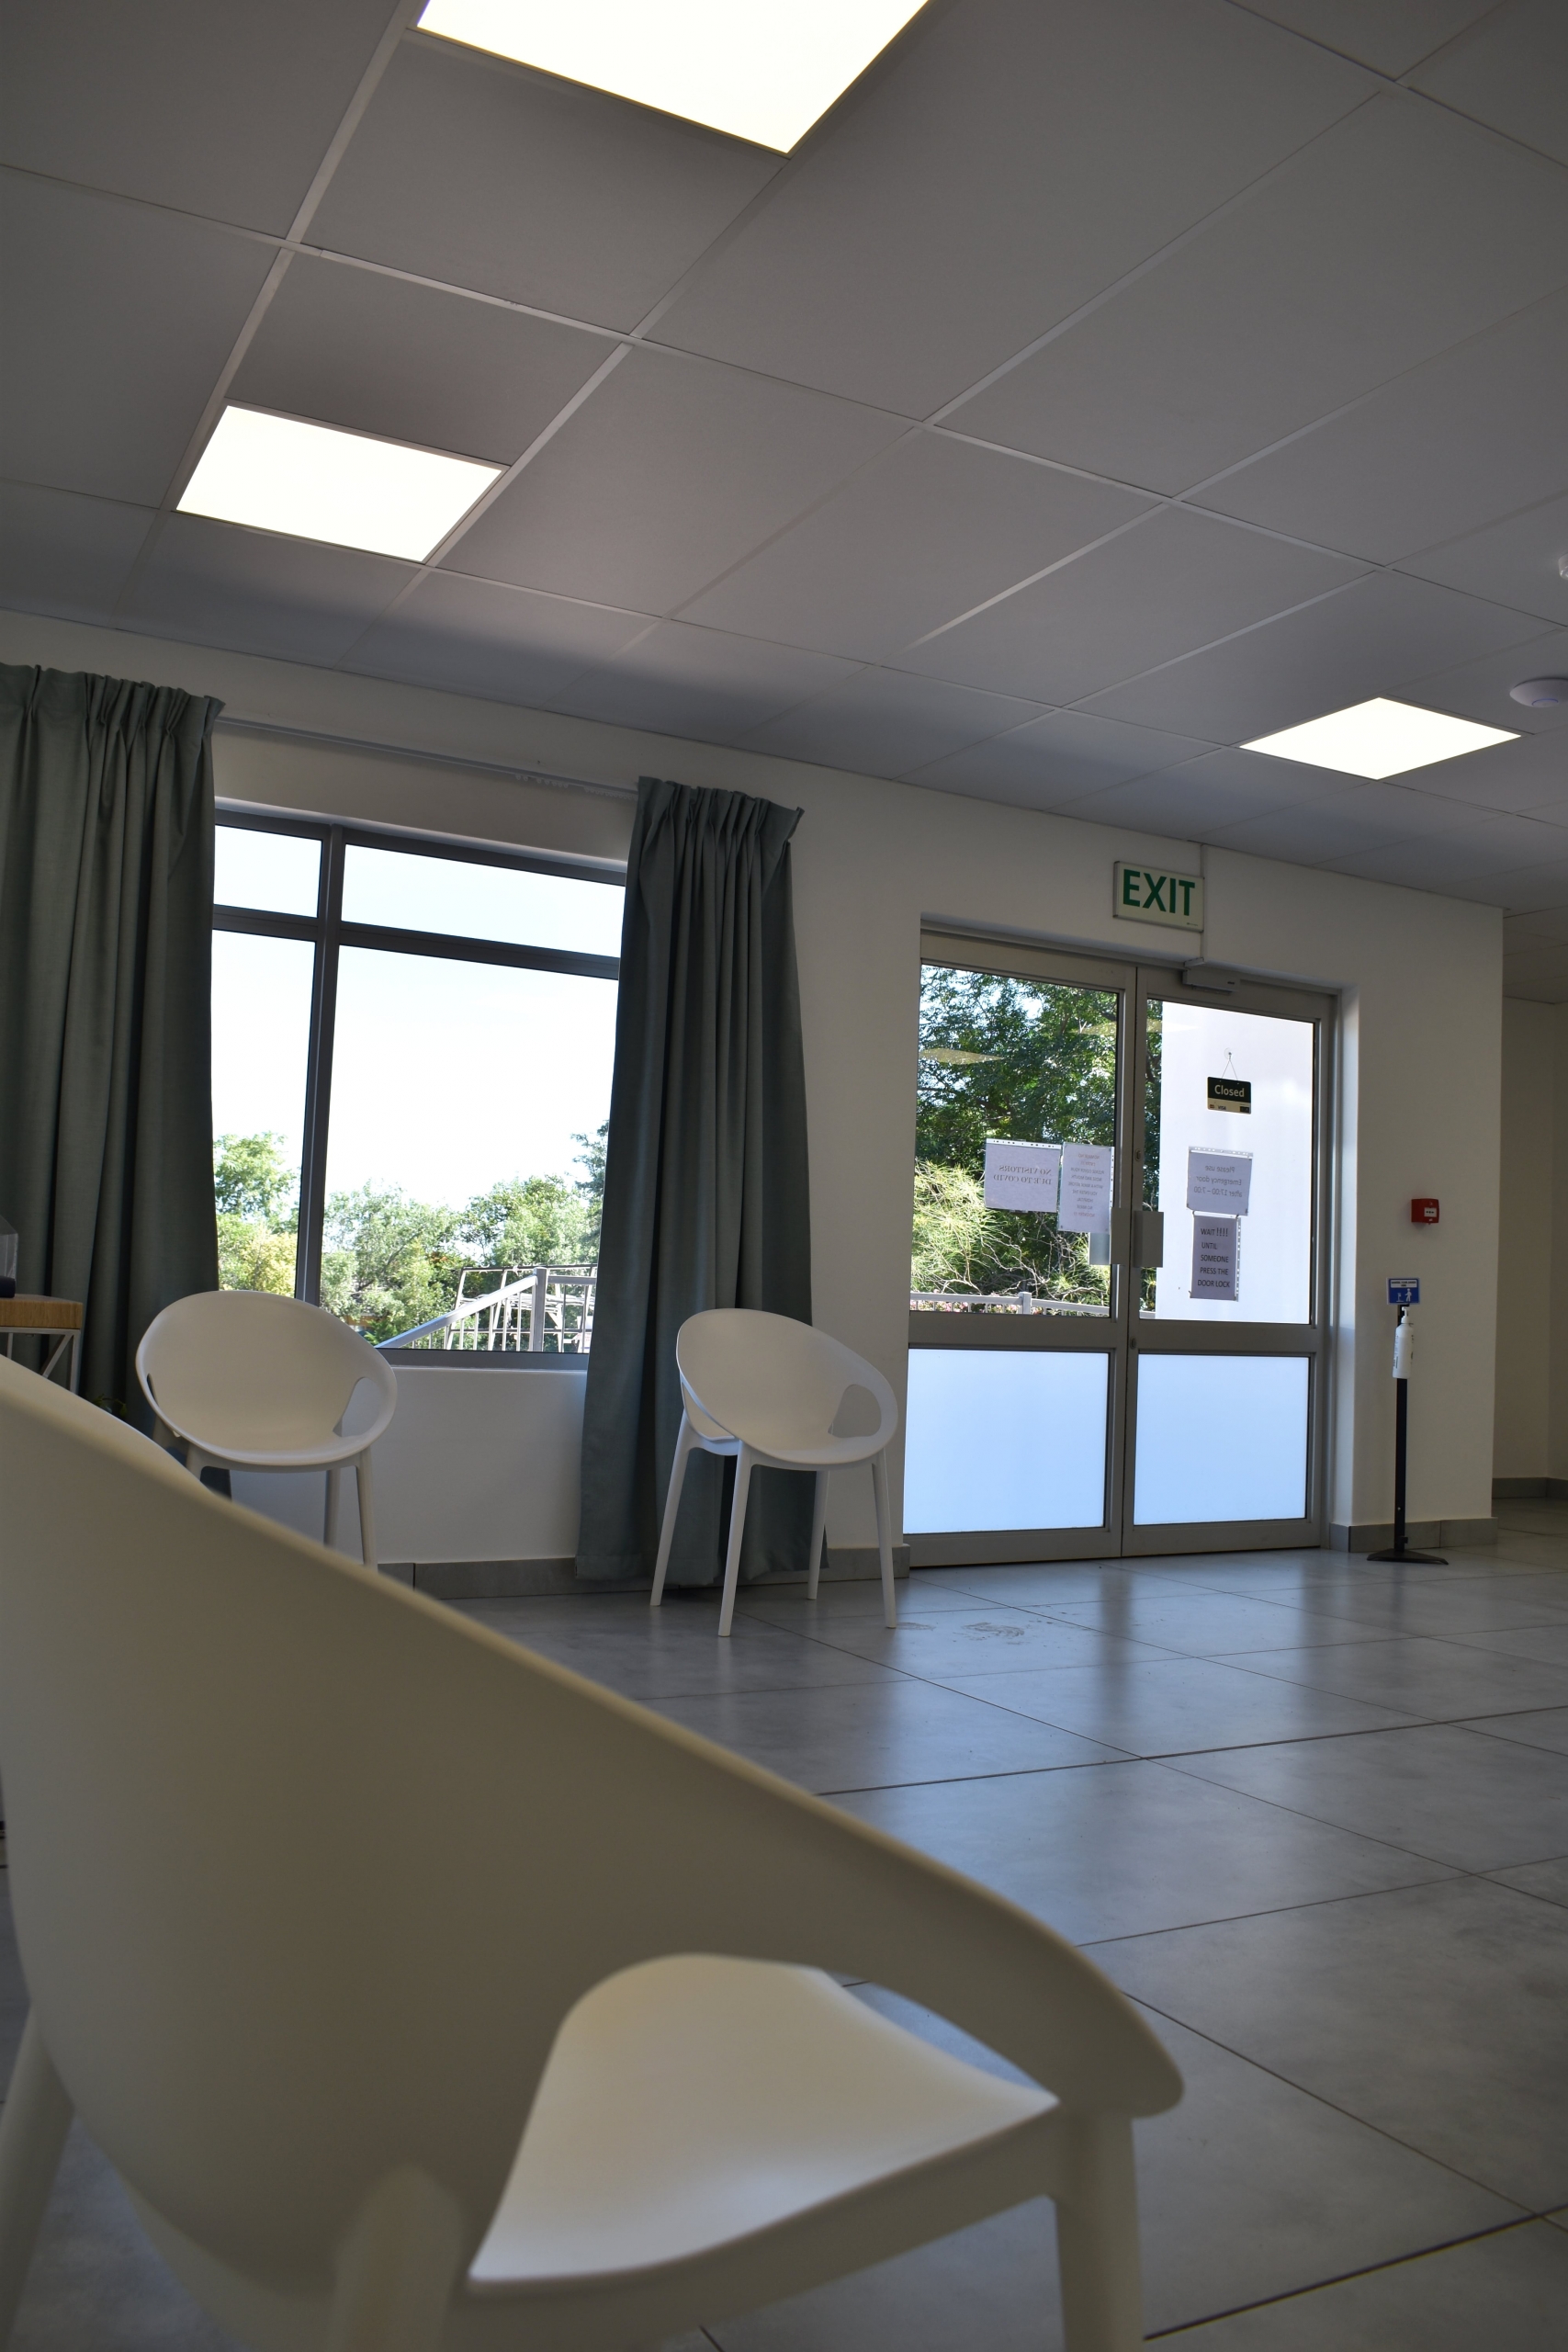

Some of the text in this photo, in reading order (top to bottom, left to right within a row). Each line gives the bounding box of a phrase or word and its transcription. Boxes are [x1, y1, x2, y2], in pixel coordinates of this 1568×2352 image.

[1122, 868, 1196, 917] EXIT
[1214, 1084, 1245, 1098] Closed
[1200, 1227, 1215, 1236] WAIT
[1200, 1254, 1229, 1263] SOMEONE
[1200, 1267, 1217, 1275] PRESS
[1197, 1279, 1214, 1287] DOOR
